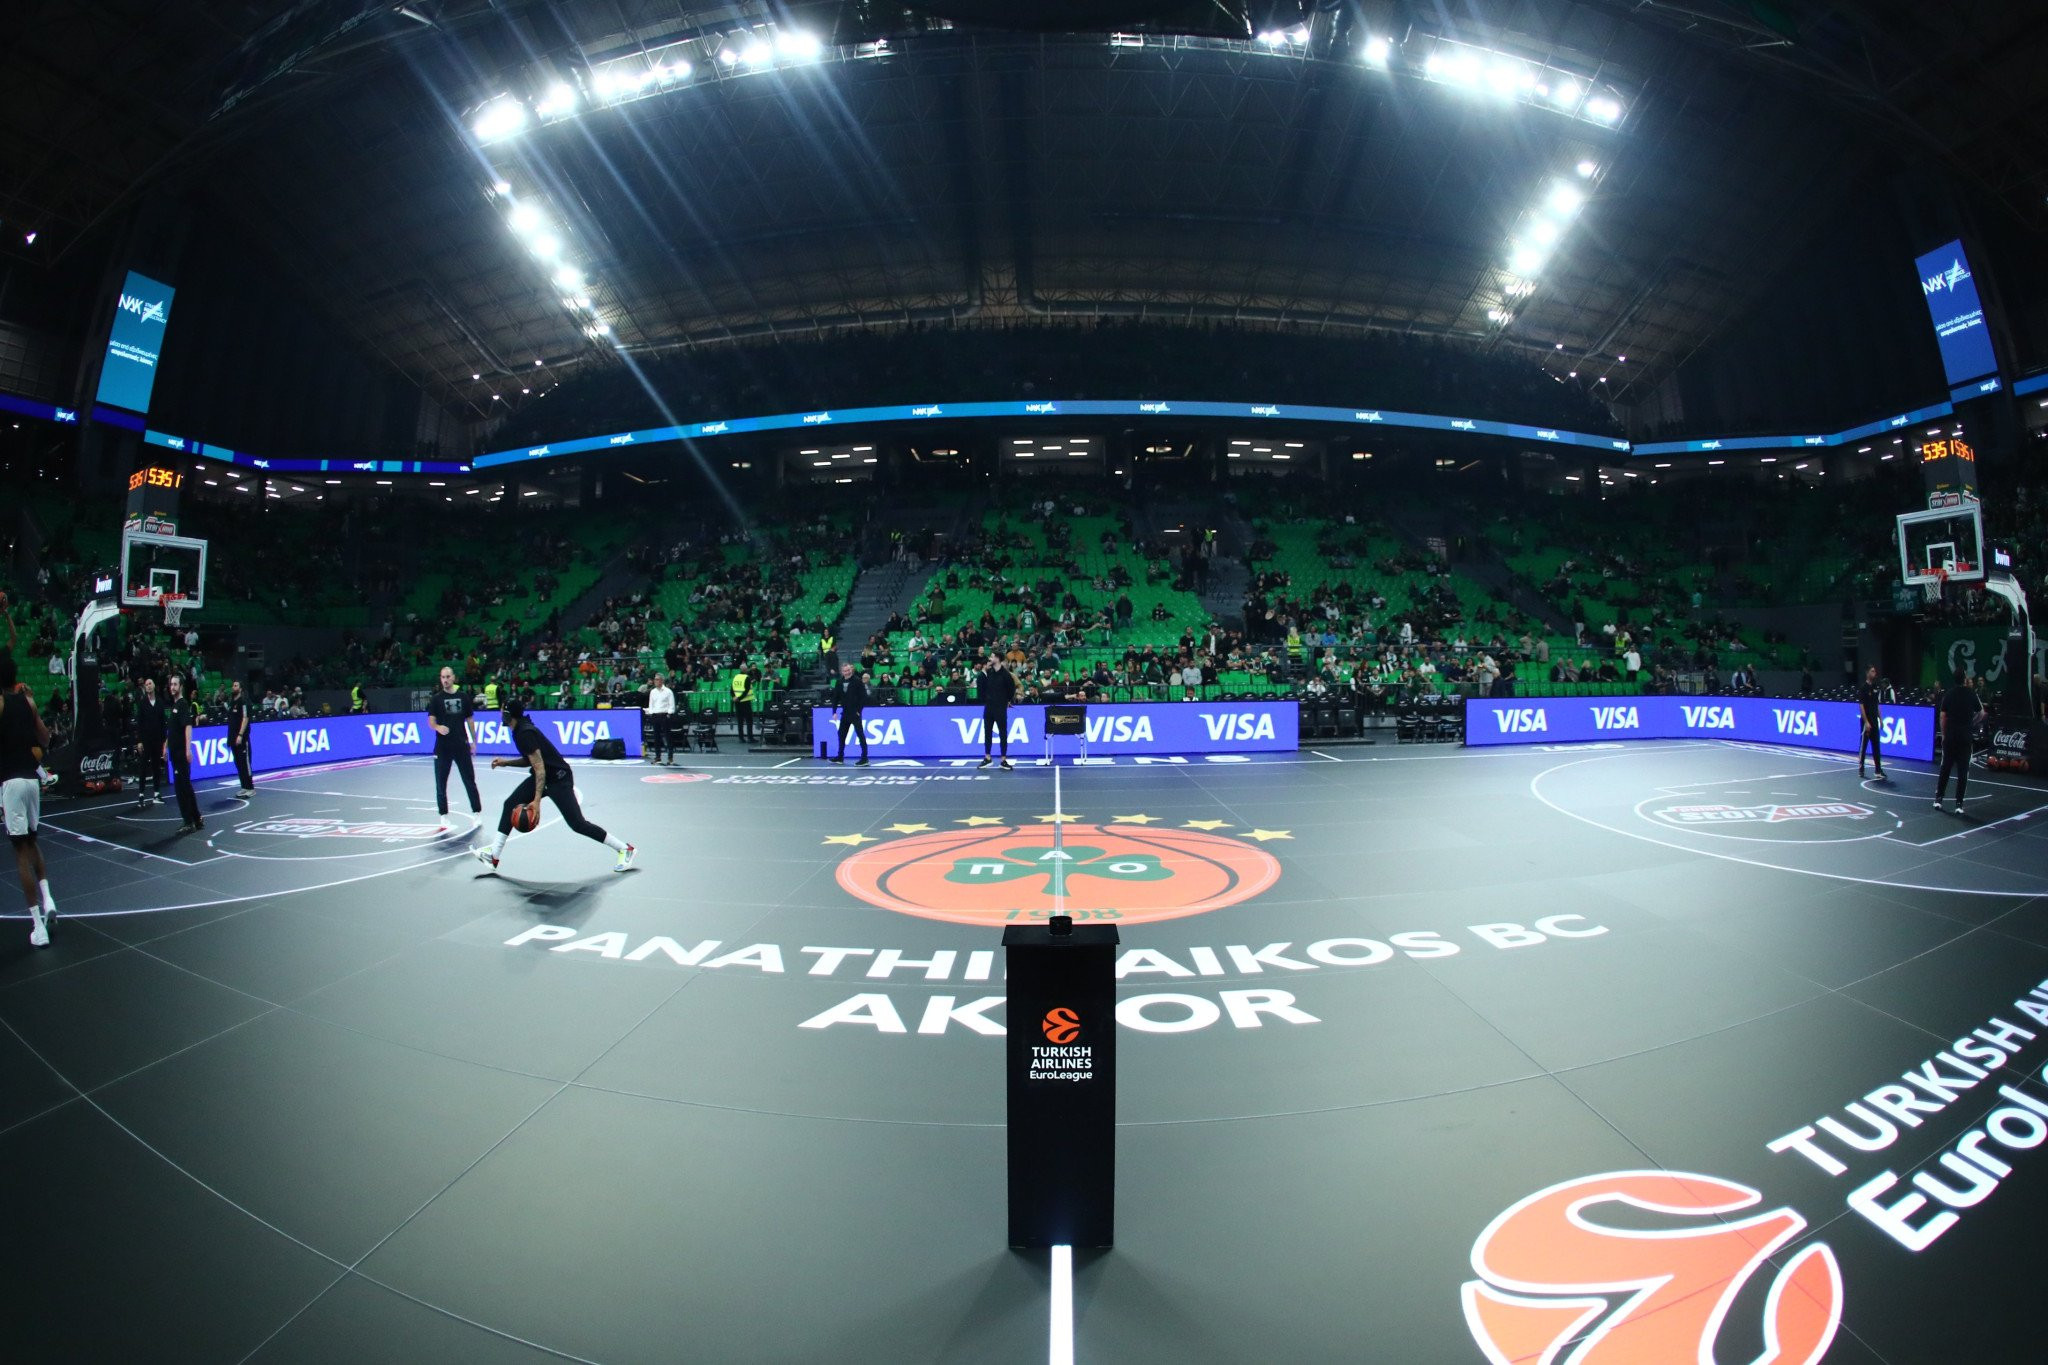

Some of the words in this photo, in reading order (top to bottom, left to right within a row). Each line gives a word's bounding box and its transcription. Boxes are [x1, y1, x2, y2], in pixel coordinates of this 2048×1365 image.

[1086, 716, 1153, 742] VISA
[1199, 714, 1275, 740] VISA
[1492, 709, 1547, 733] VISA
[1590, 707, 1639, 729] VISA
[1680, 706, 1734, 729] VISA
[1773, 709, 1818, 736] VISA
[283, 728, 330, 755] VISA
[366, 721, 420, 746] VISA
[464, 721, 511, 744] VISA
[553, 721, 610, 745] VISA
[191, 737, 234, 766] VIS
[503, 923, 1460, 980] PANATHIAIKOS
[1466, 914, 1610, 949] BC
[798, 988, 1322, 1035] AKOR
[1031, 1046, 1091, 1057] TURKISH
[1031, 1058, 1092, 1069] AIRLINES
[1029, 1070, 1093, 1082] EuroLeague
[1765, 1017, 2037, 1177] TURKISH
[1847, 1064, 2048, 1252] Euro
